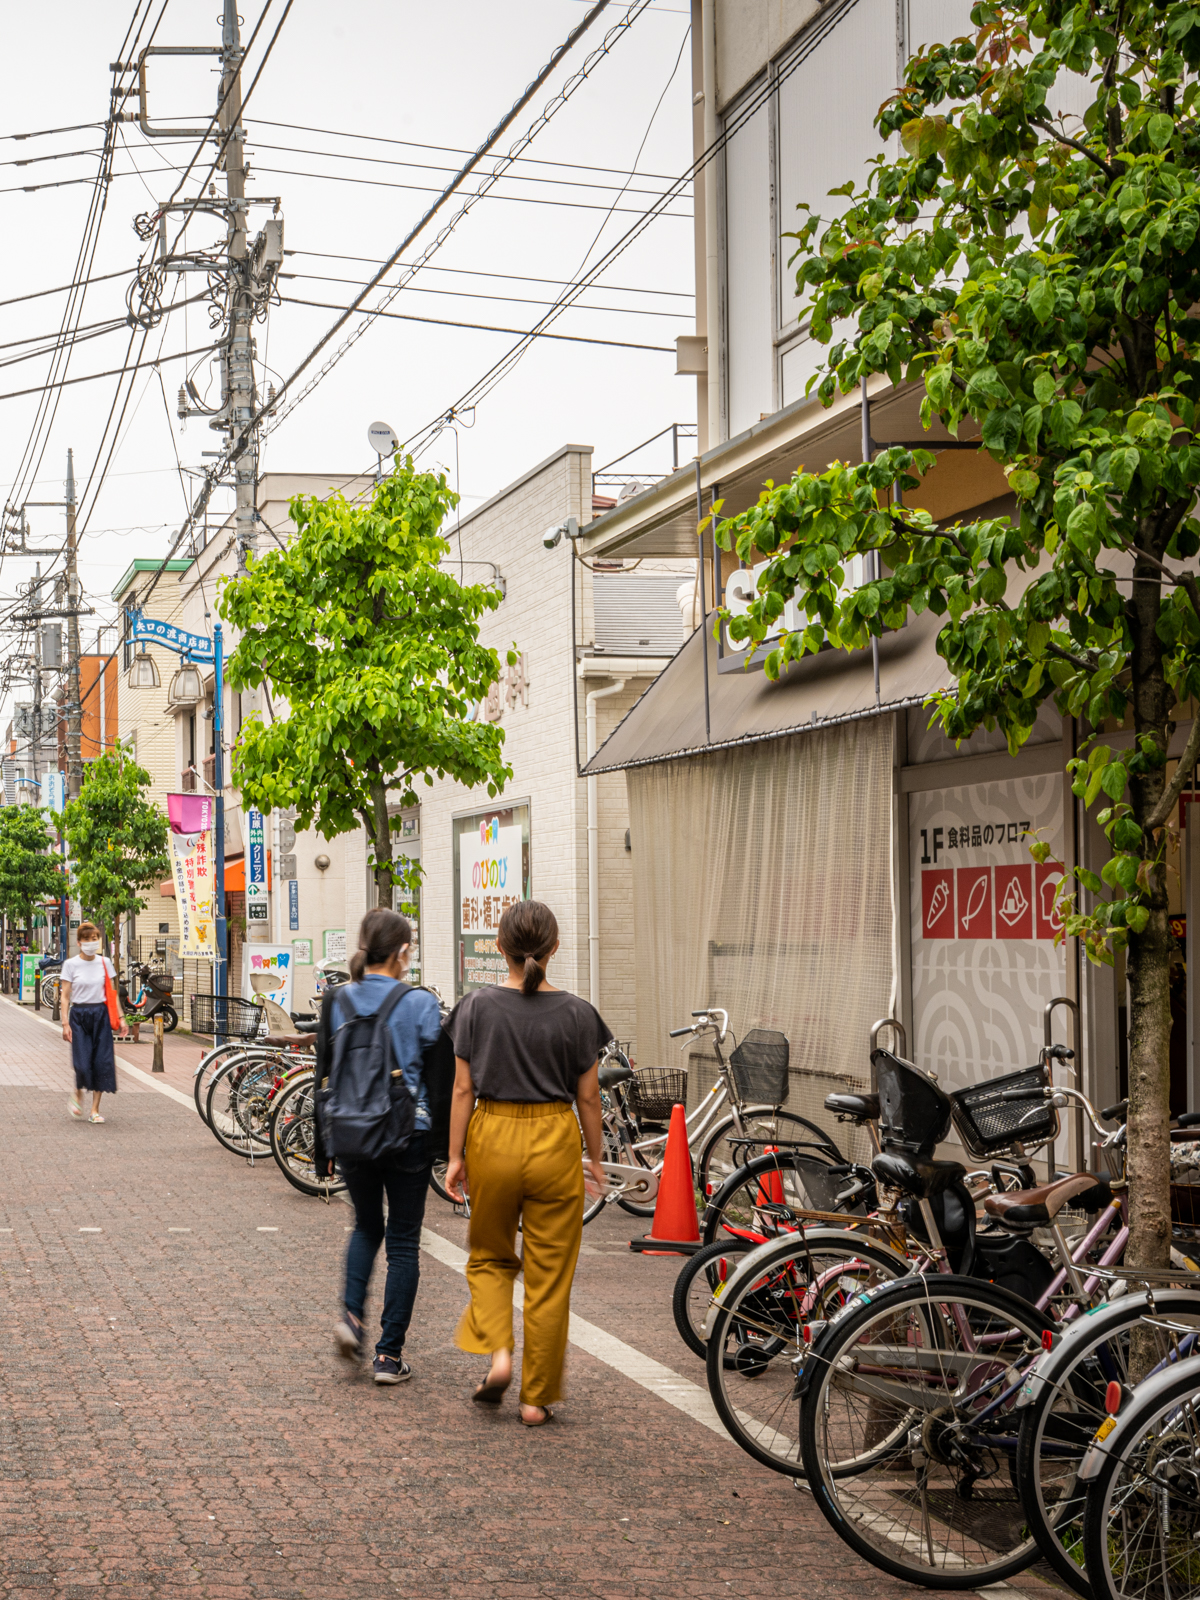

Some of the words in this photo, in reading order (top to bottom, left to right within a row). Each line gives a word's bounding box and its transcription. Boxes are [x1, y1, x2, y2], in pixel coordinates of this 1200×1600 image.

[136, 621, 209, 651] 矢口の渡商店街
[921, 827, 943, 864] 1F
[948, 821, 1031, 849] 食料品のフロア
[253, 845, 262, 882] クリニック
[472, 856, 508, 891] のびのび
